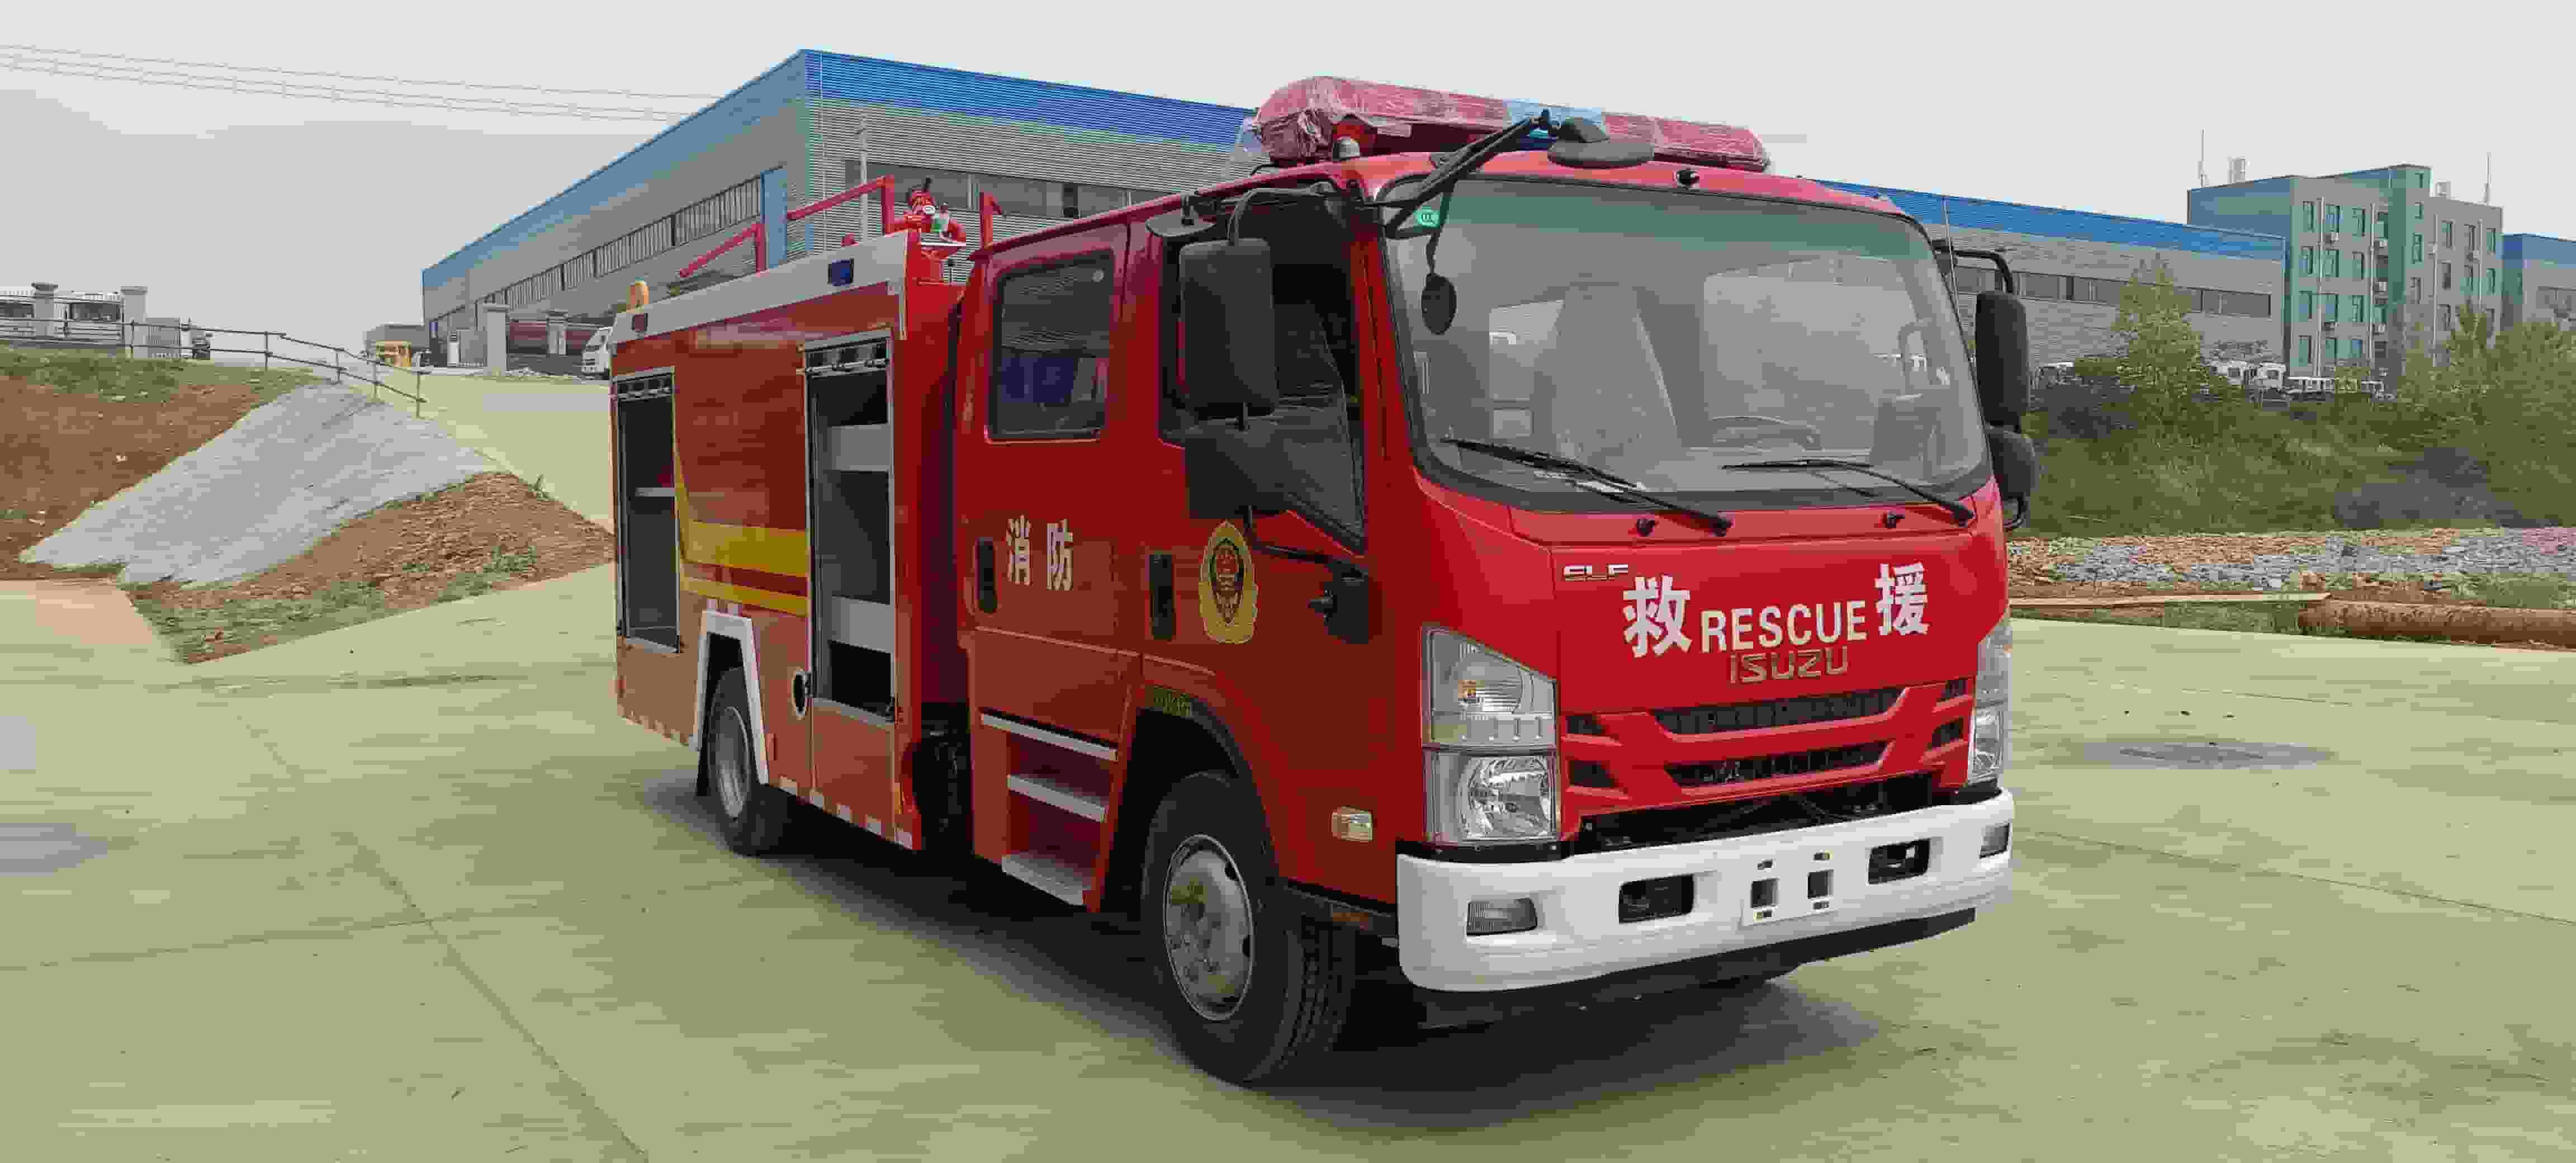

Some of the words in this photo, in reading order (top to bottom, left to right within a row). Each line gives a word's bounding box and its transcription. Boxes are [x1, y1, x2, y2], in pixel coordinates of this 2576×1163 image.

[1006, 514, 1074, 591] 消防
[1623, 574, 1693, 658] 救
[1699, 600, 1868, 653] RESCUE
[1874, 561, 1930, 636] 援
[1730, 645, 1848, 684] ISUZU
